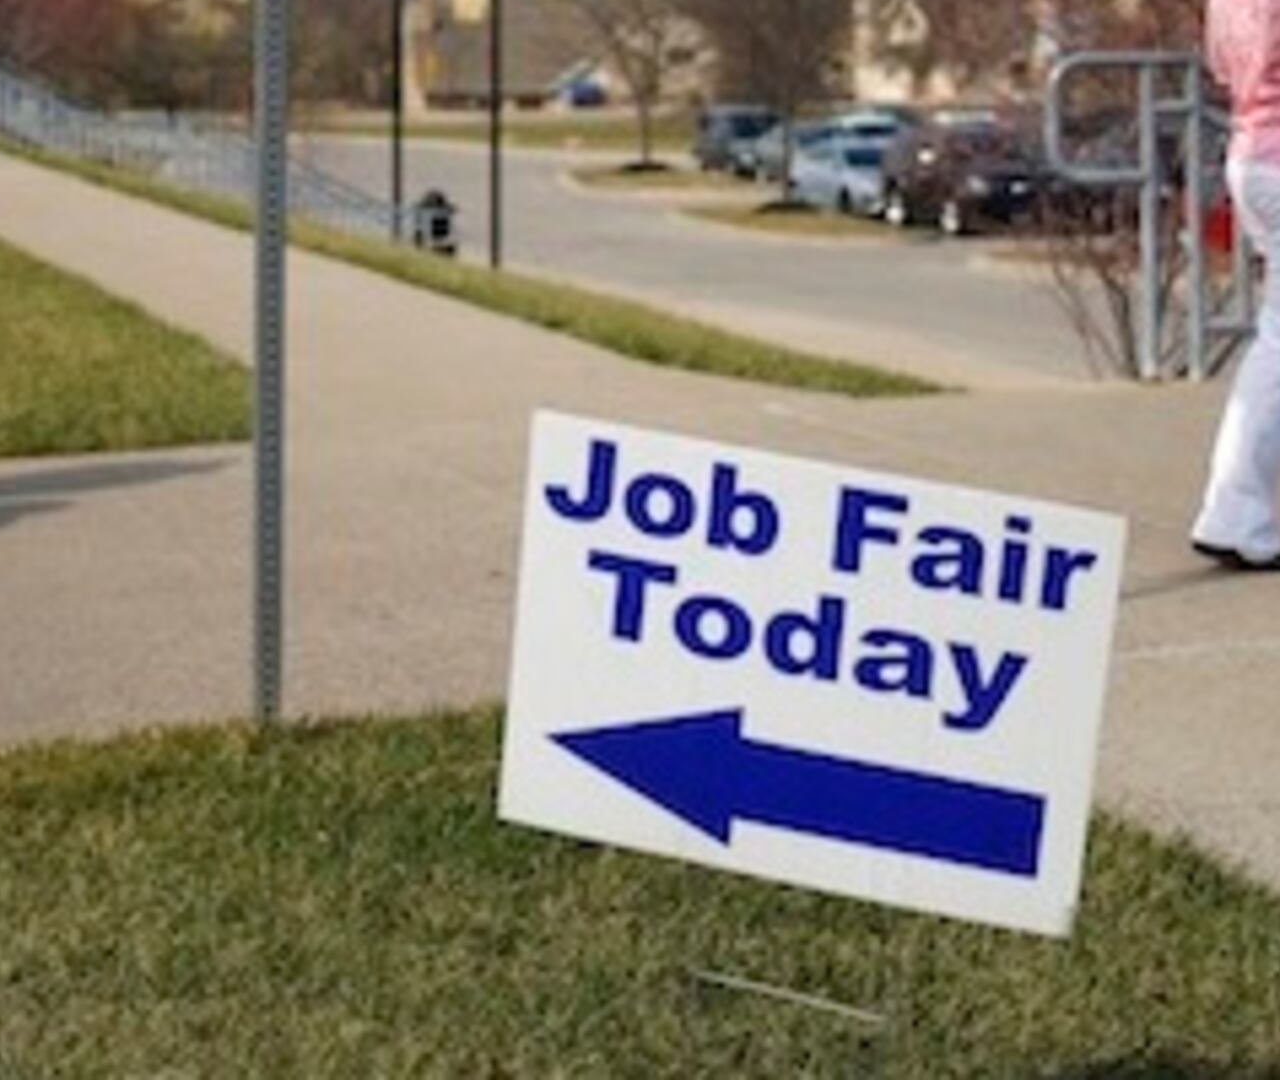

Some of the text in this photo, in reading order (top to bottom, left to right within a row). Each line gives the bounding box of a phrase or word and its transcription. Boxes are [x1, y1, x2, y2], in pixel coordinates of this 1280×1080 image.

[543, 439, 1095, 612] Job Fair
[587, 550, 1028, 732] Today
